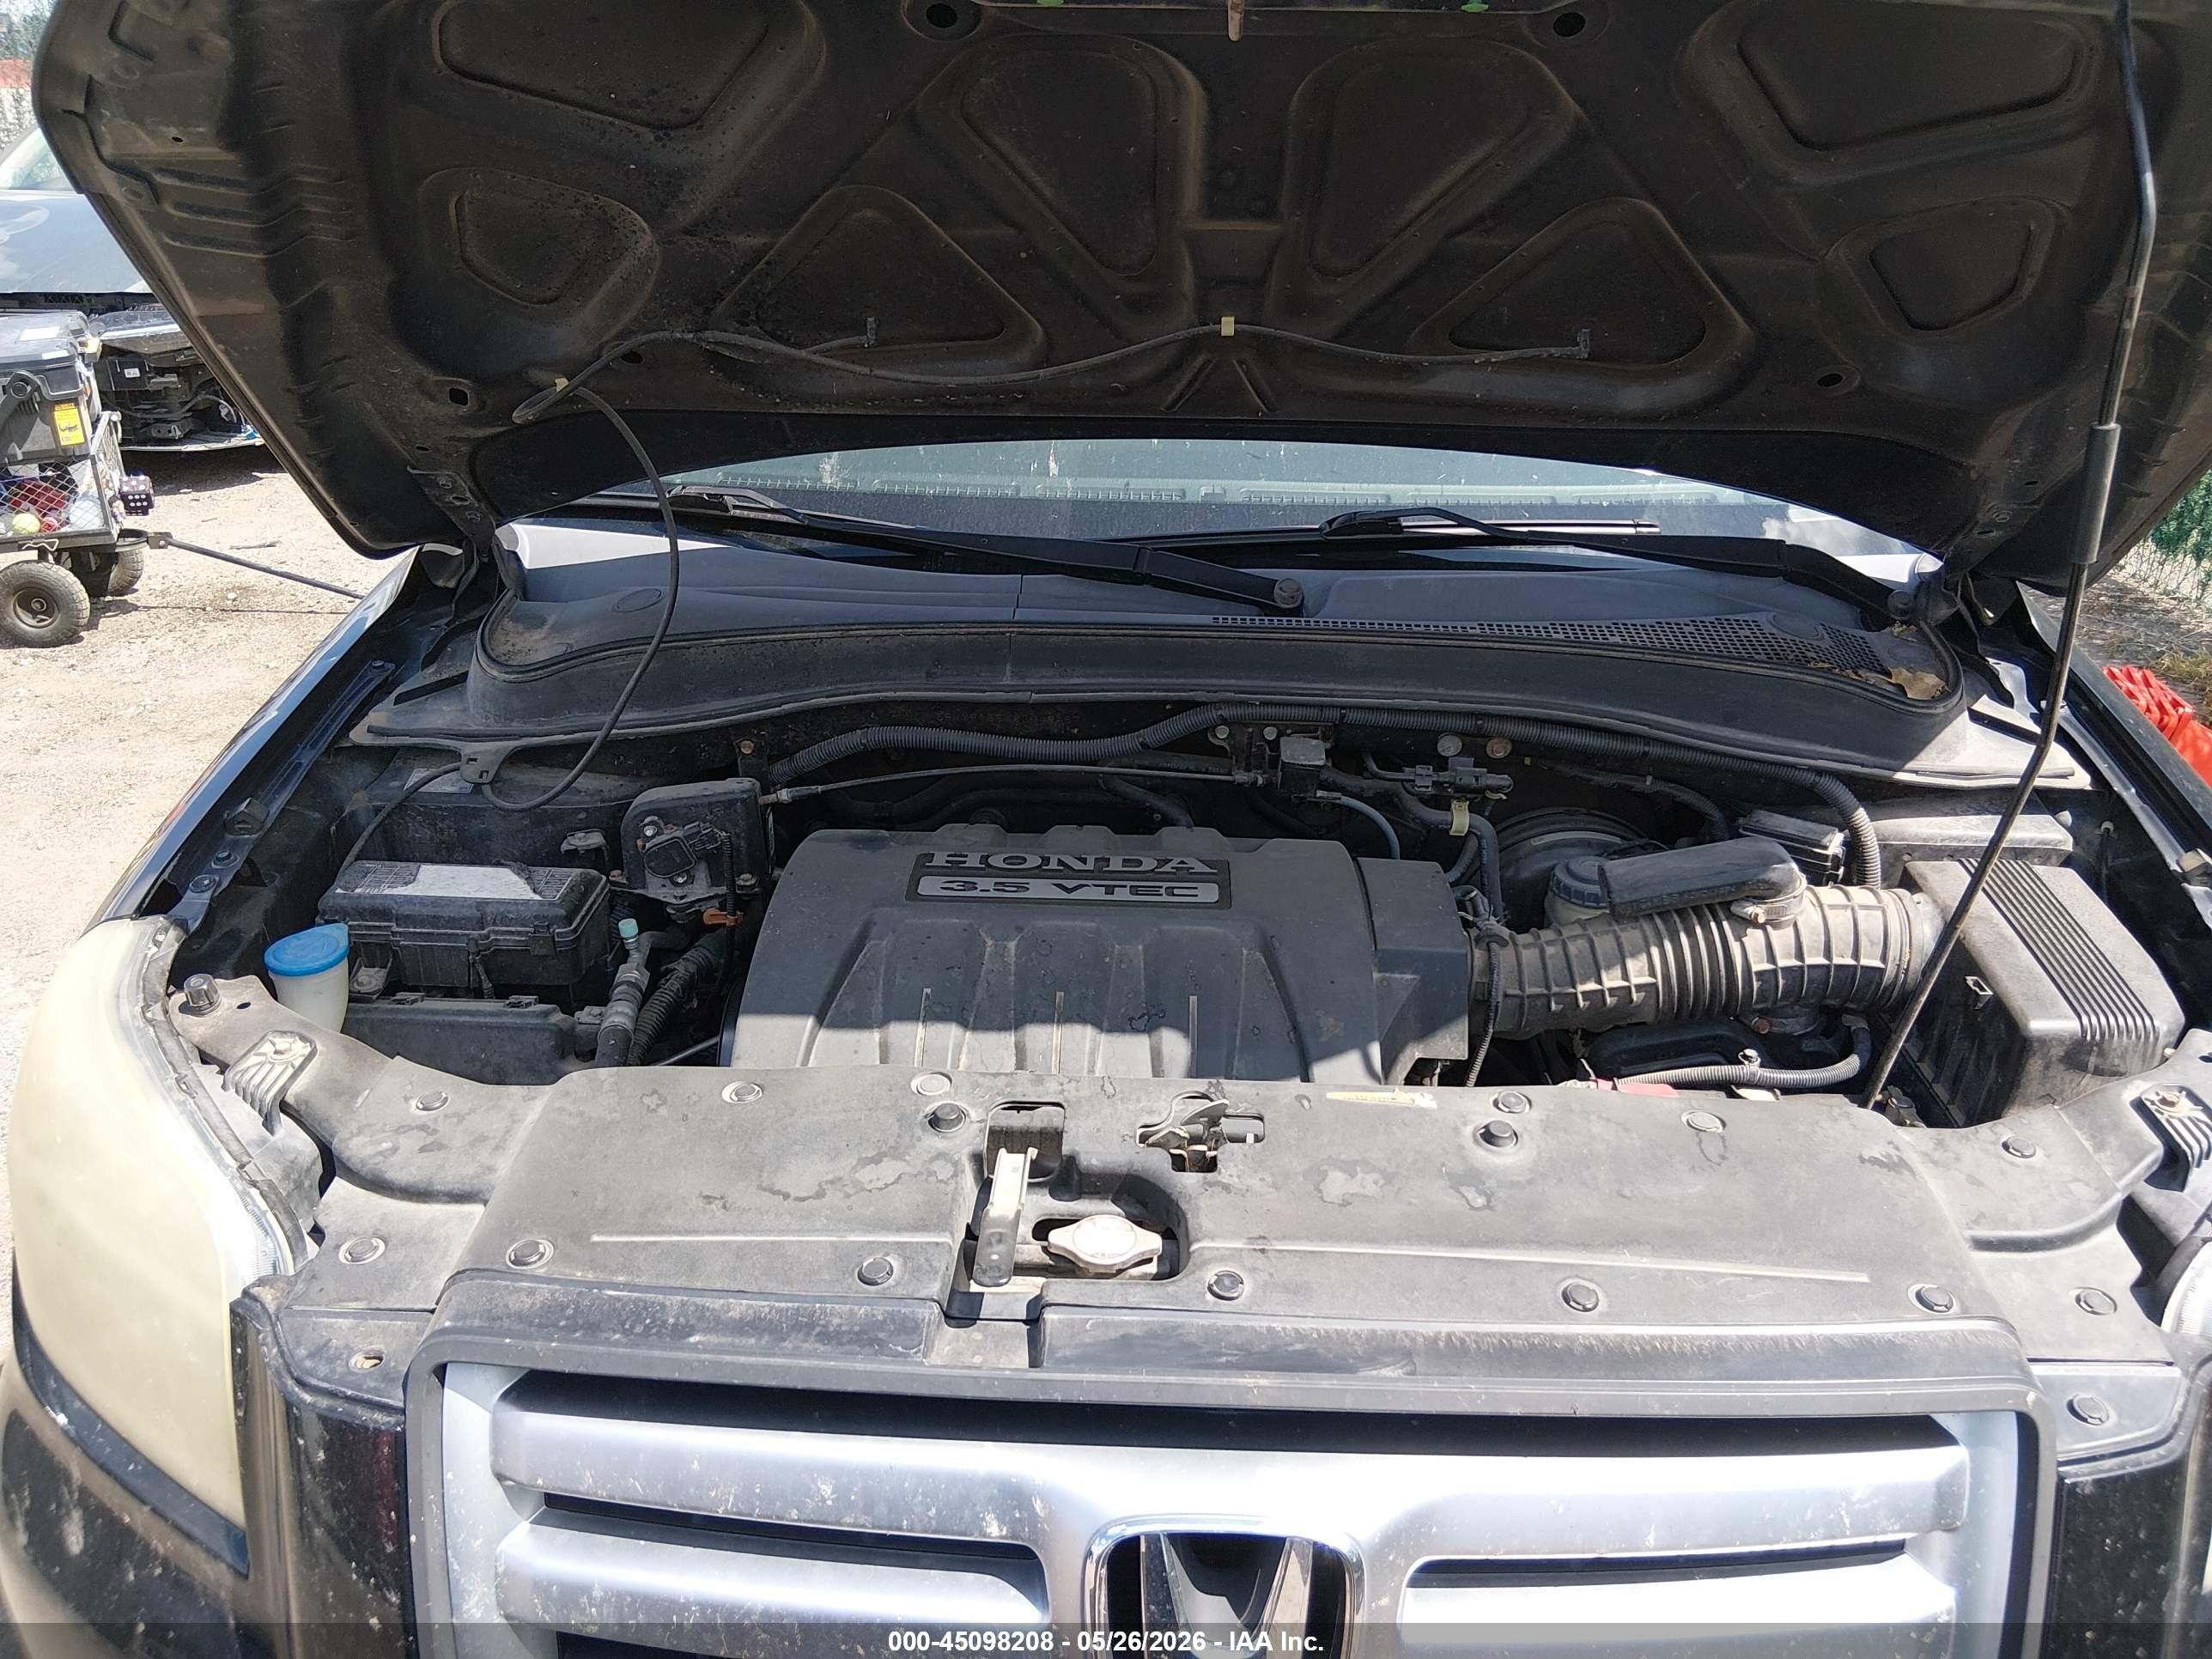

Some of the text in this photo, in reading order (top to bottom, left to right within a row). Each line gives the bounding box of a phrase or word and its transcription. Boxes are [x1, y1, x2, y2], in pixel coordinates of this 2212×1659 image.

[926, 851, 1218, 873] HONDA
[940, 880, 1200, 898] 3.5 VTEC
